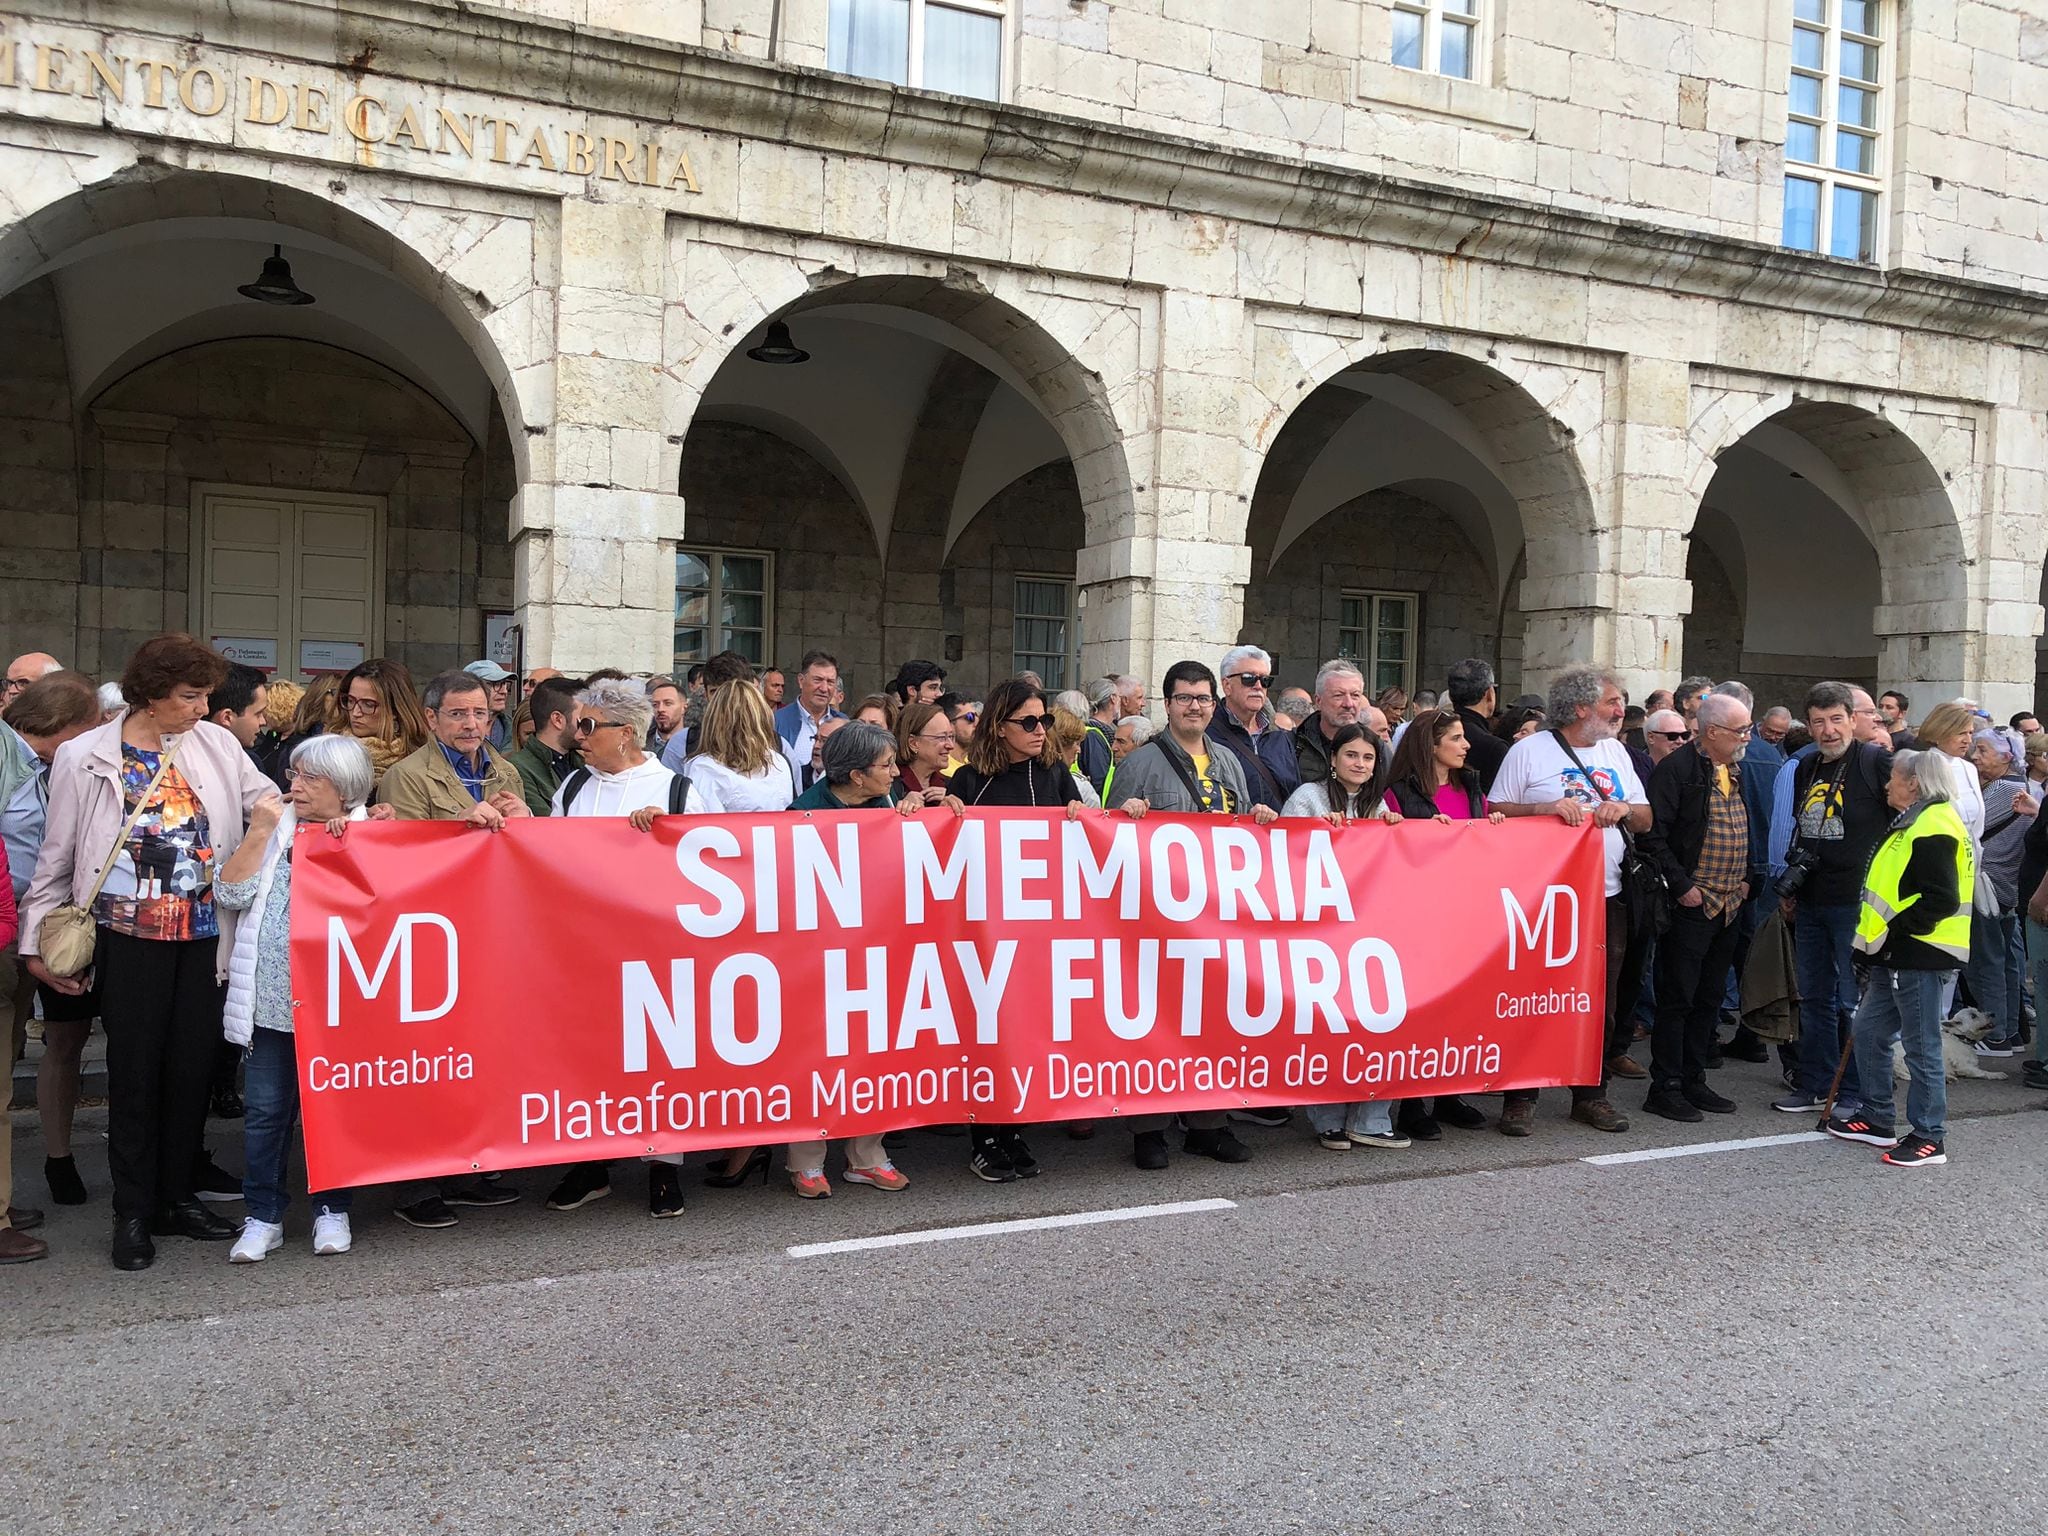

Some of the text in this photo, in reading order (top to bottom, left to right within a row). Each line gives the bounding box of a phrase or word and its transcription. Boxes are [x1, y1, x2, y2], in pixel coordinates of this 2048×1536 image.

[244, 76, 331, 134] DE
[345, 95, 703, 194] CANTABRIA
[676, 819, 1357, 938] SIN MEMORIA
[1500, 884, 1579, 971] MD
[327, 912, 459, 1027] MD
[621, 936, 1408, 1073] NO HAY FUTURO
[1495, 986, 1591, 1019] Cantabria
[309, 1046, 474, 1092] Cantabria
[520, 1035, 1500, 1144] Plataforma Memoria y Democracia de Cantabria
